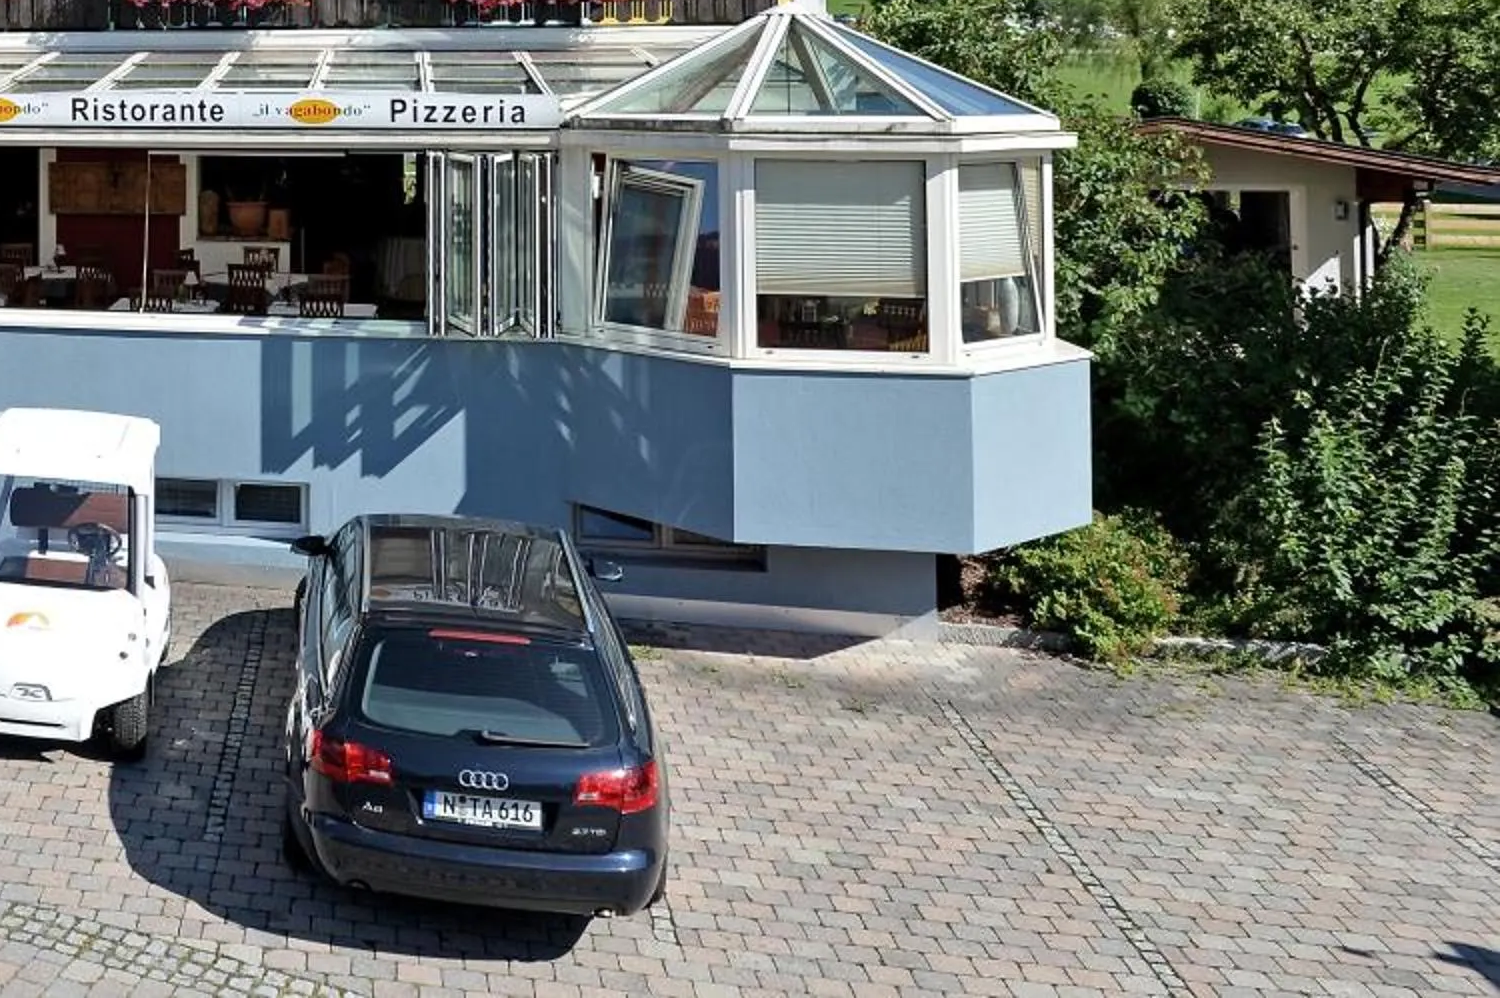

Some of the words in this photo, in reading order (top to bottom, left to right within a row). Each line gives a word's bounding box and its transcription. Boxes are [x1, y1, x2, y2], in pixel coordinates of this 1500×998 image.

[72, 98, 225, 123] Ristorante
[390, 99, 526, 123] Pizzeria
[470, 798, 493, 819] TA
[499, 802, 533, 823] 616
